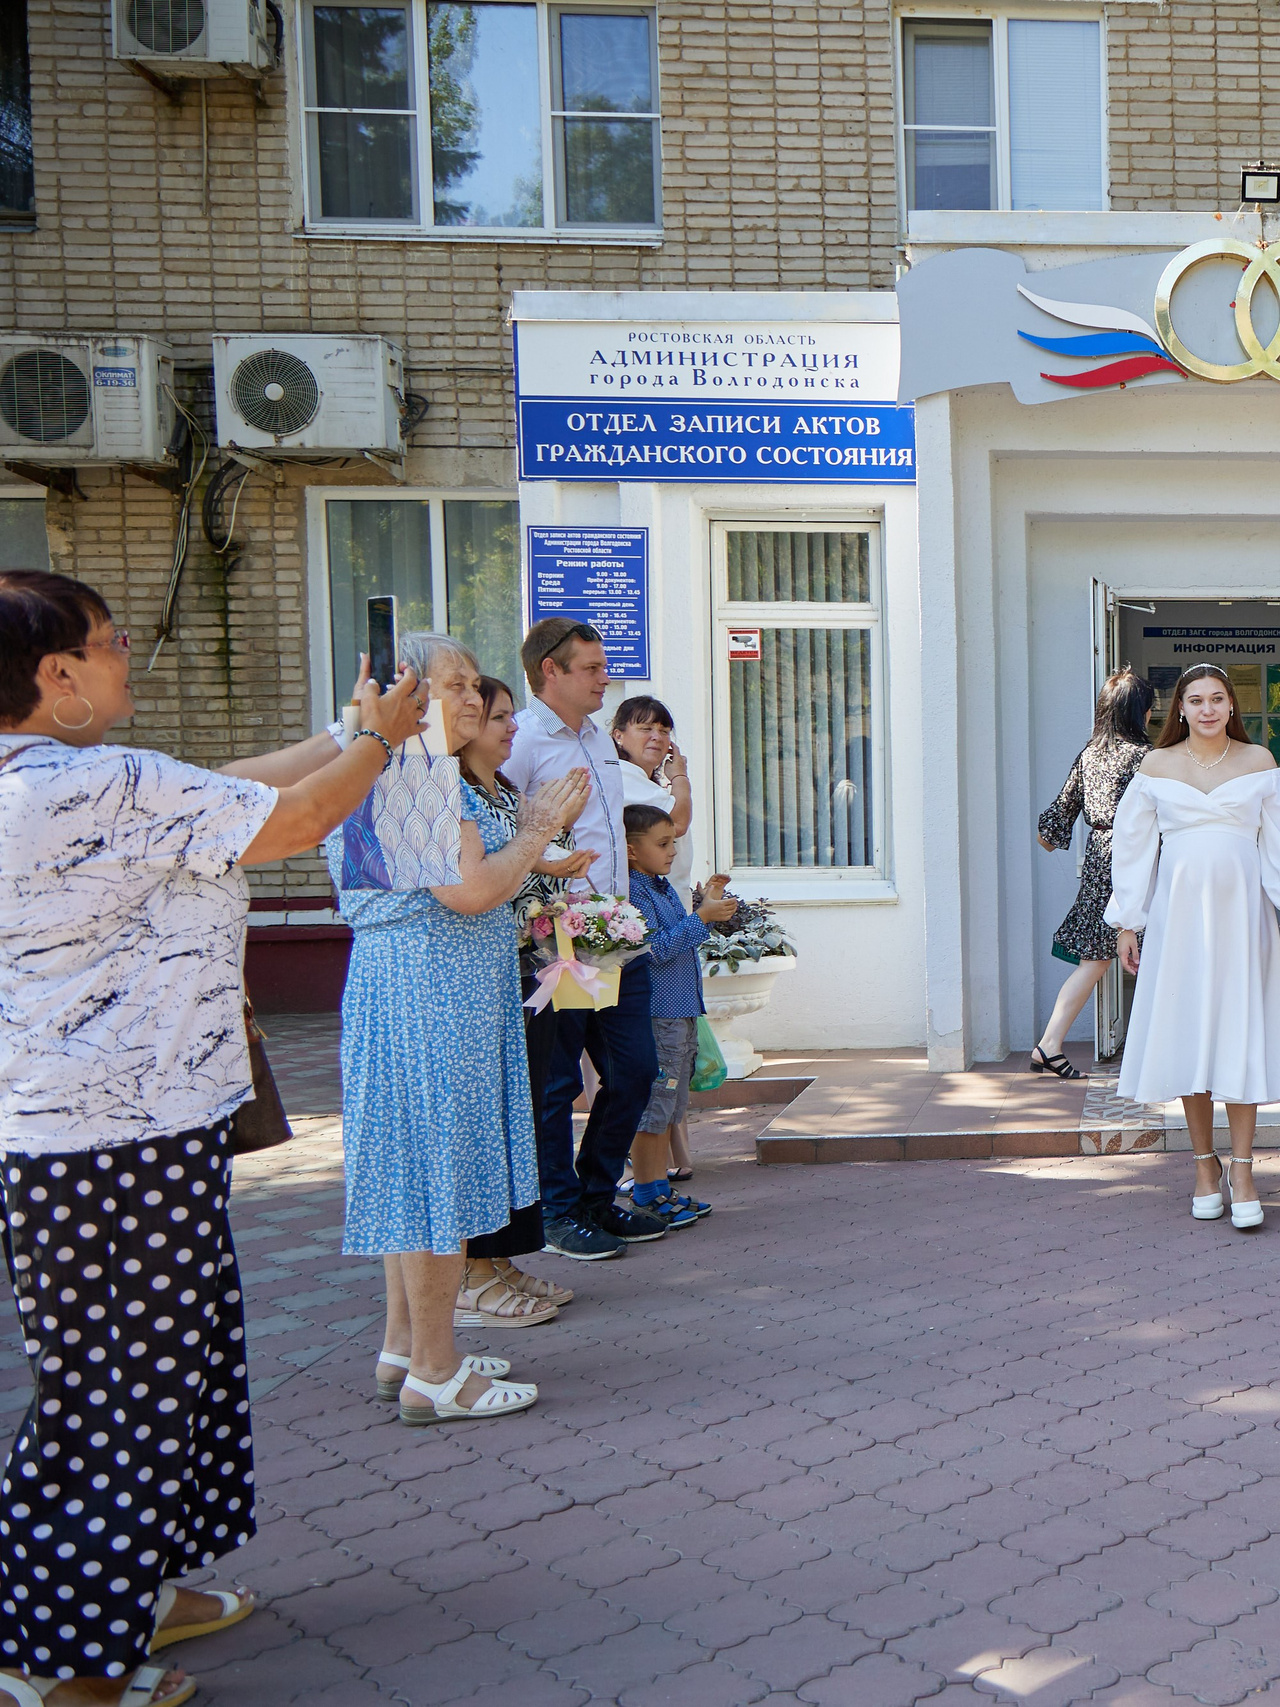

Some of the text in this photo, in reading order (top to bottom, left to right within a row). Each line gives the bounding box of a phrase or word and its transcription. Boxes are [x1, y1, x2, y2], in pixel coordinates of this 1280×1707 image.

[628, 332, 816, 346] РОСТОВСКАЯ ОБЛАСТЬ
[589, 349, 859, 372] АДМИНИСТРАЦИЯ
[590, 369, 861, 390] города Волгодонска
[567, 413, 881, 436] ОТДЕЛ ЗАПИСИ АКТОВ
[536, 444, 913, 467] ГРАЖДАНСКОГО СОСТОЯНИЯ
[544, 539, 581, 547] Администрации
[591, 560, 624, 568] работы
[1162, 629, 1186, 637] ОТДЕЛ
[1189, 629, 1207, 637] ЗАГС
[1208, 630, 1232, 638] города
[1173, 643, 1276, 654] ИНФОРМАЦИЯ
